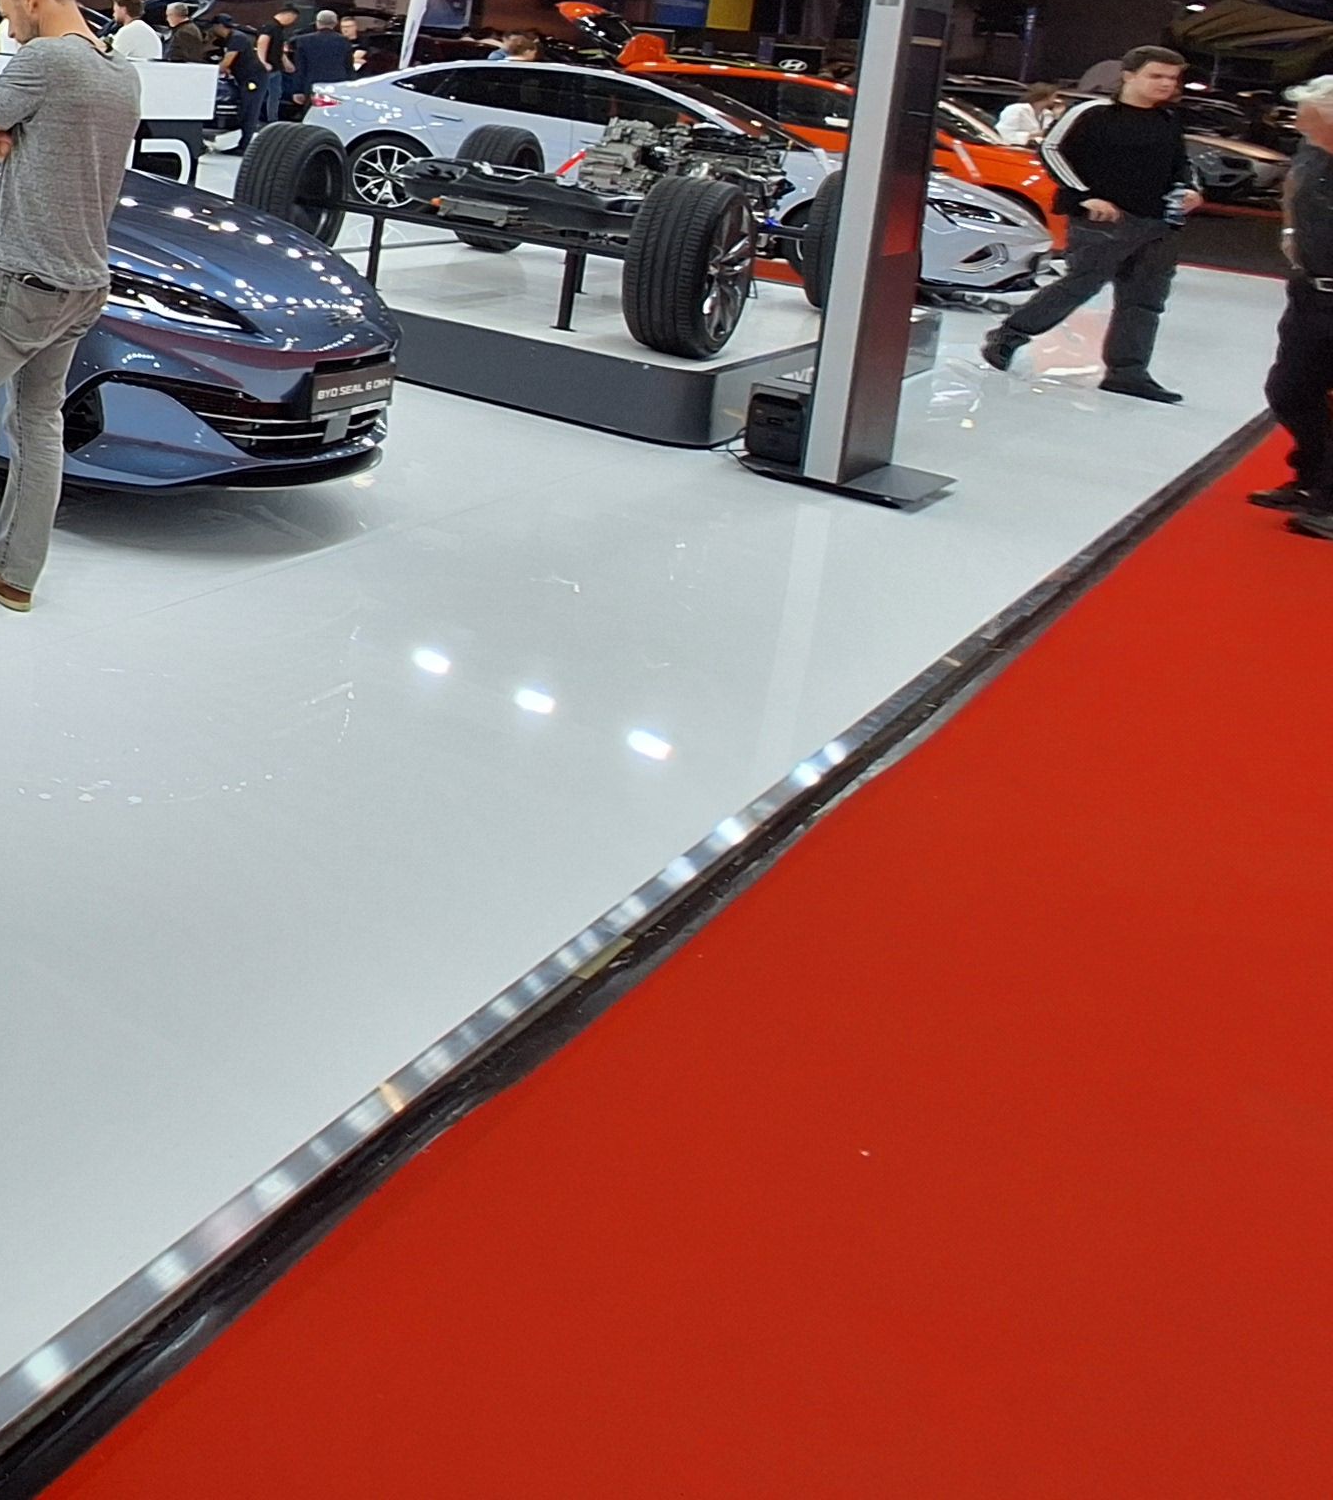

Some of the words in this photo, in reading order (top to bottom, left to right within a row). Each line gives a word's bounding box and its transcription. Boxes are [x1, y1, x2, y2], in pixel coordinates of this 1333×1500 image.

[317, 387, 339, 400] BYD
[338, 383, 364, 396] SEAL
[365, 381, 373, 391] 6
